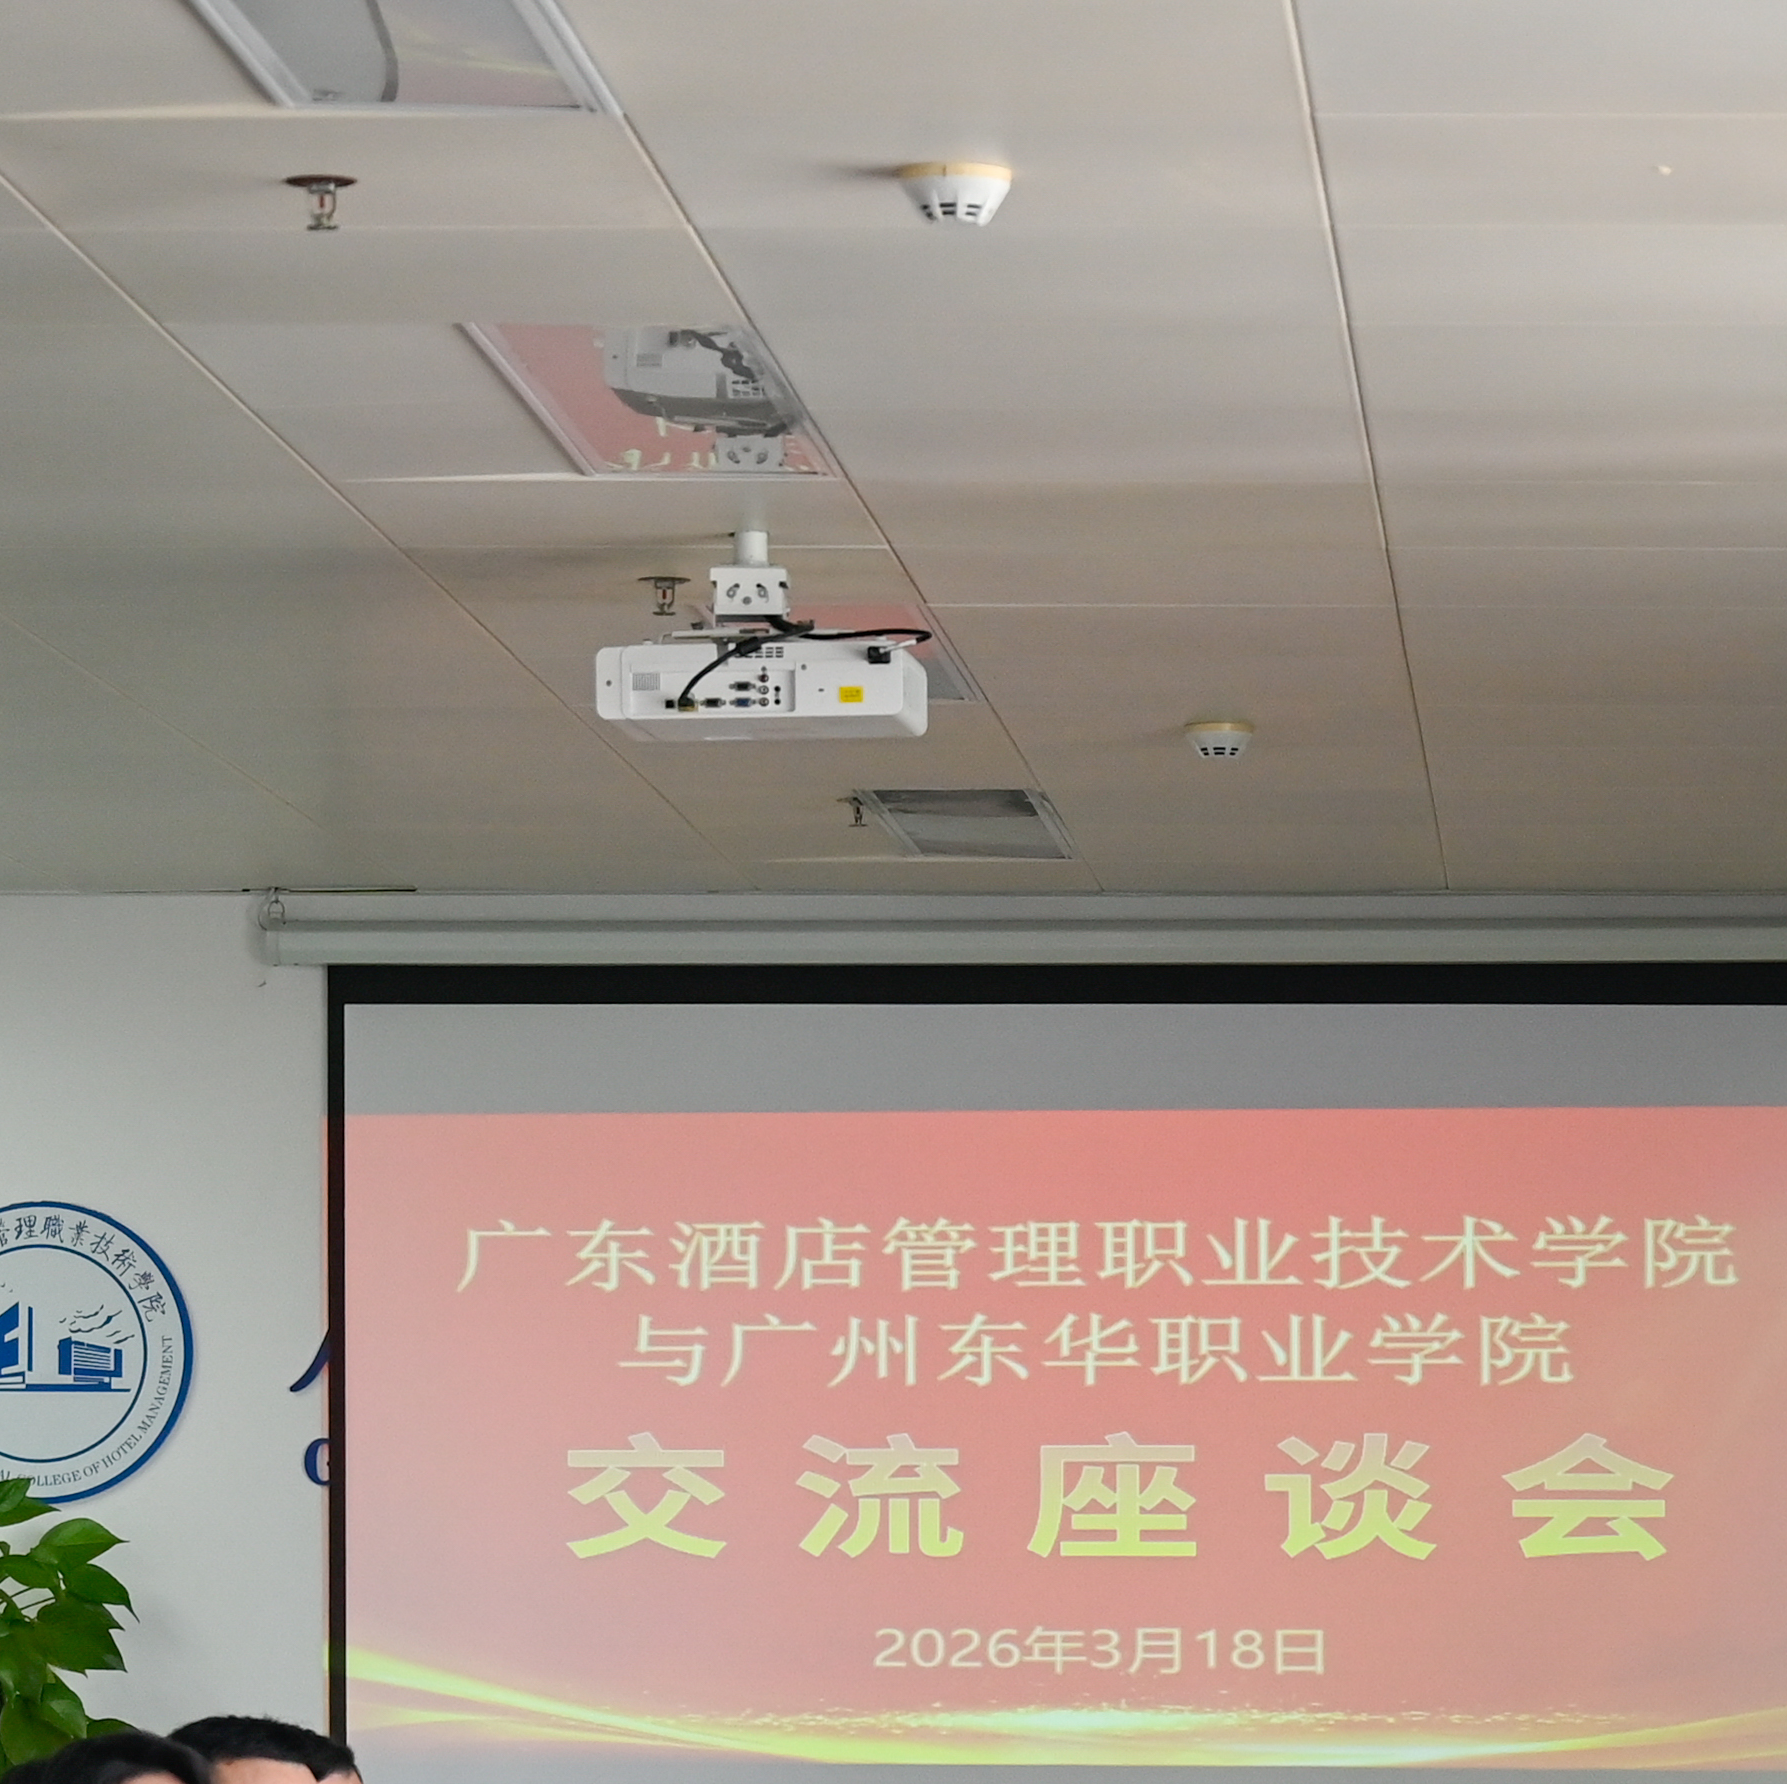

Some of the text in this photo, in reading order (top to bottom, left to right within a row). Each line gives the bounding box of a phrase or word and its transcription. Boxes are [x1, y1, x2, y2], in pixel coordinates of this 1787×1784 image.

[455, 1214, 1742, 1294] 广东酒店管理职业技术学院
[616, 1312, 1578, 1390] 与广州东华职业学院
[82, 1461, 101, 1477] OF
[101, 1434, 143, 1470] HOTEL
[136, 1334, 175, 1437] MANAGEMENT
[564, 1432, 1675, 1562] 交流座谈会
[872, 1624, 1329, 1676] 2026年3月18日
